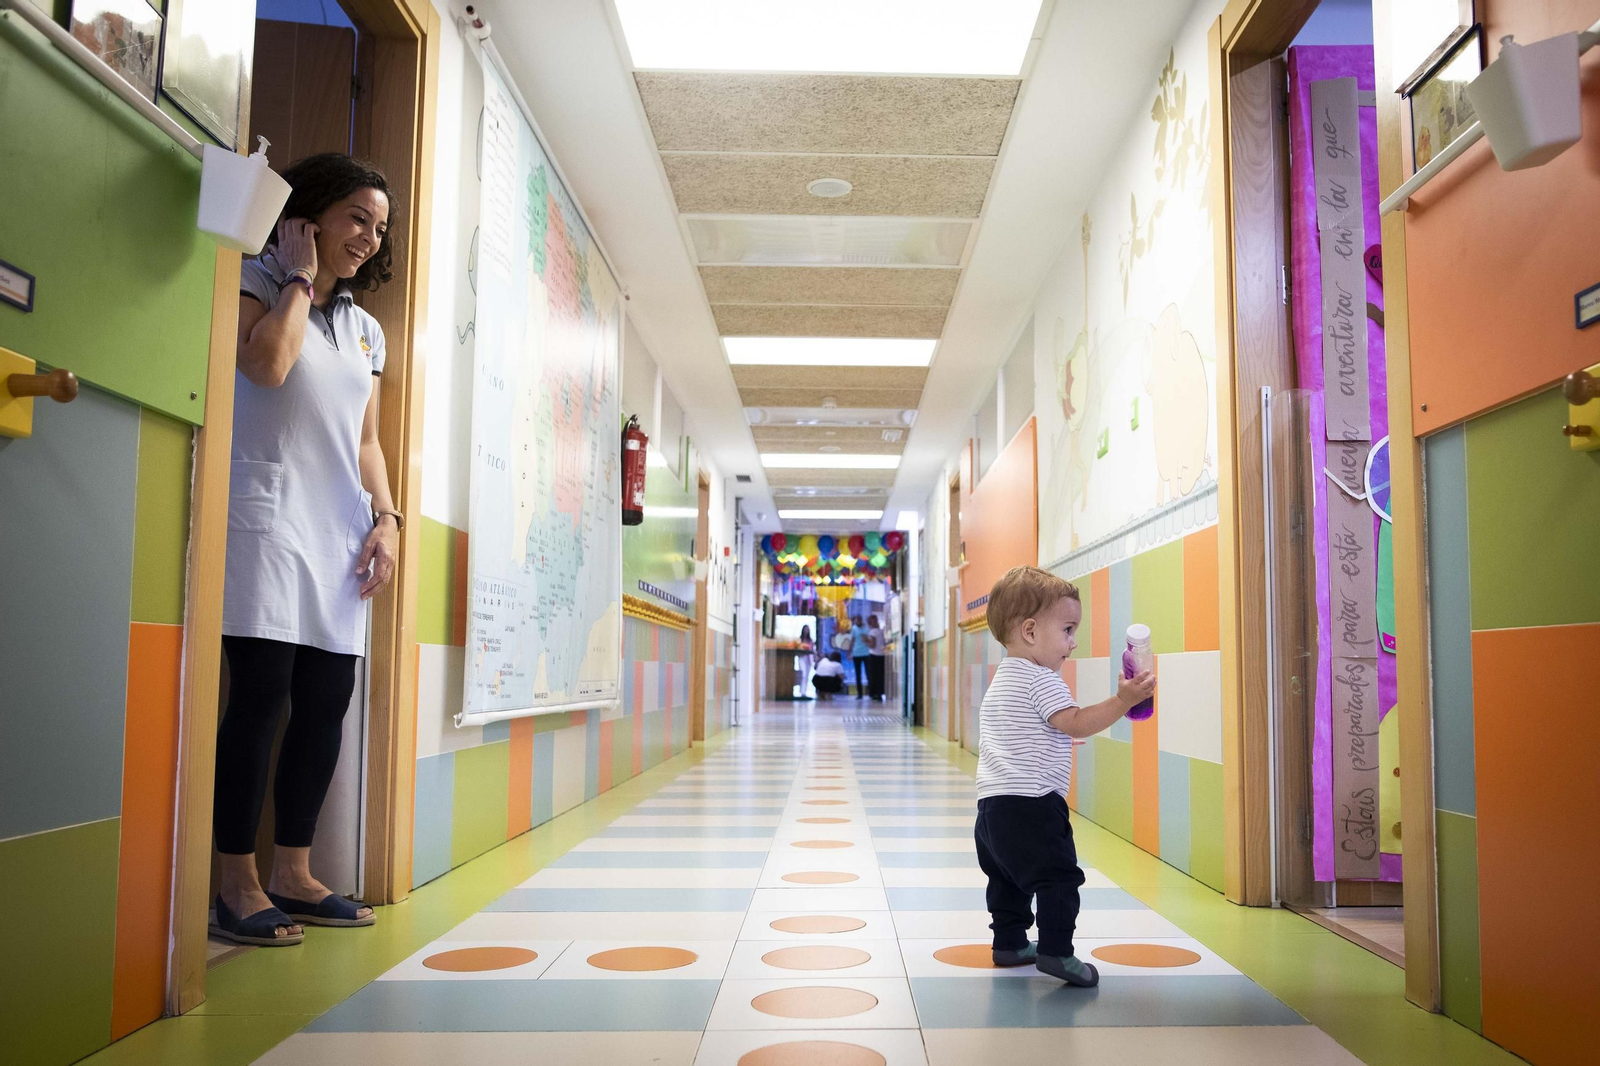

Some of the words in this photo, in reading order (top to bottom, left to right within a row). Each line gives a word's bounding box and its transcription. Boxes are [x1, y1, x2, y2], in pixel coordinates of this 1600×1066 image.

[1322, 107, 1354, 159] que
[1319, 179, 1349, 213] la
[1333, 226, 1353, 262] en
[1328, 281, 1356, 397] aventura
[1335, 588, 1375, 650] para
[1335, 663, 1379, 771] preparados
[1340, 787, 1377, 861] Estais
